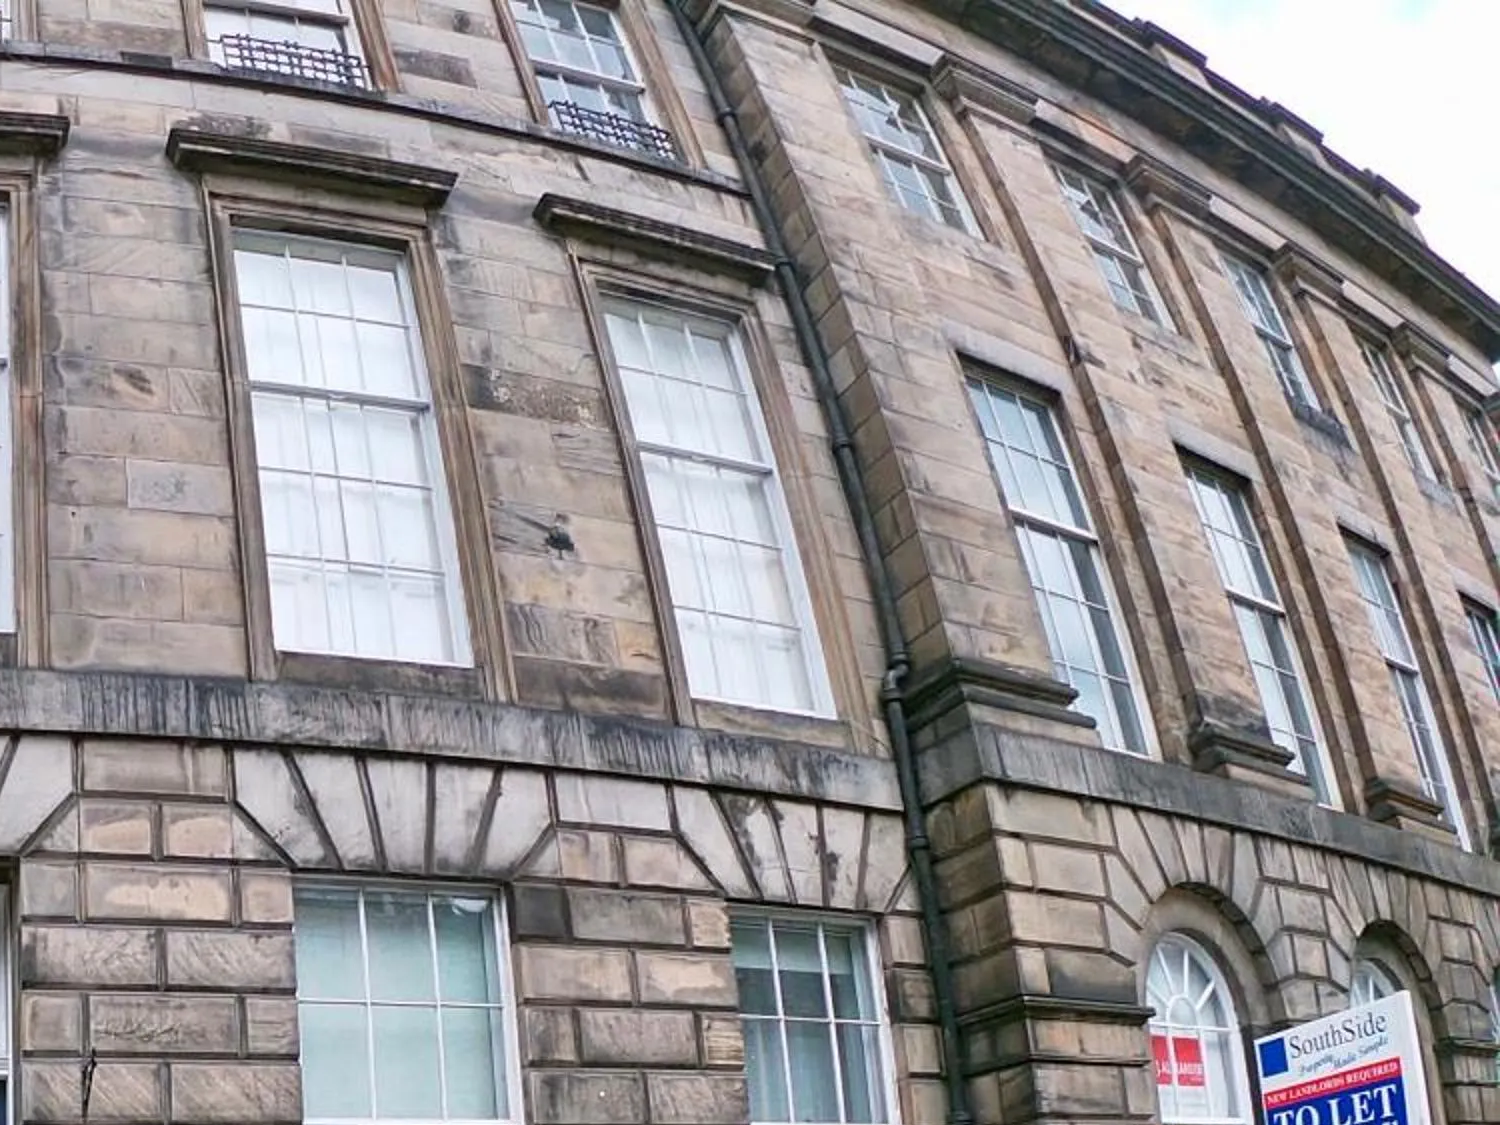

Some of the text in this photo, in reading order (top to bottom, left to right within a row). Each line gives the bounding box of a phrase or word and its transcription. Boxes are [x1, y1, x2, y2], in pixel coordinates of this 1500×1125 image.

[1289, 1012, 1387, 1058] SouthSide
[1266, 1060, 1399, 1105] NEW LANDLORDS REQUIRED
